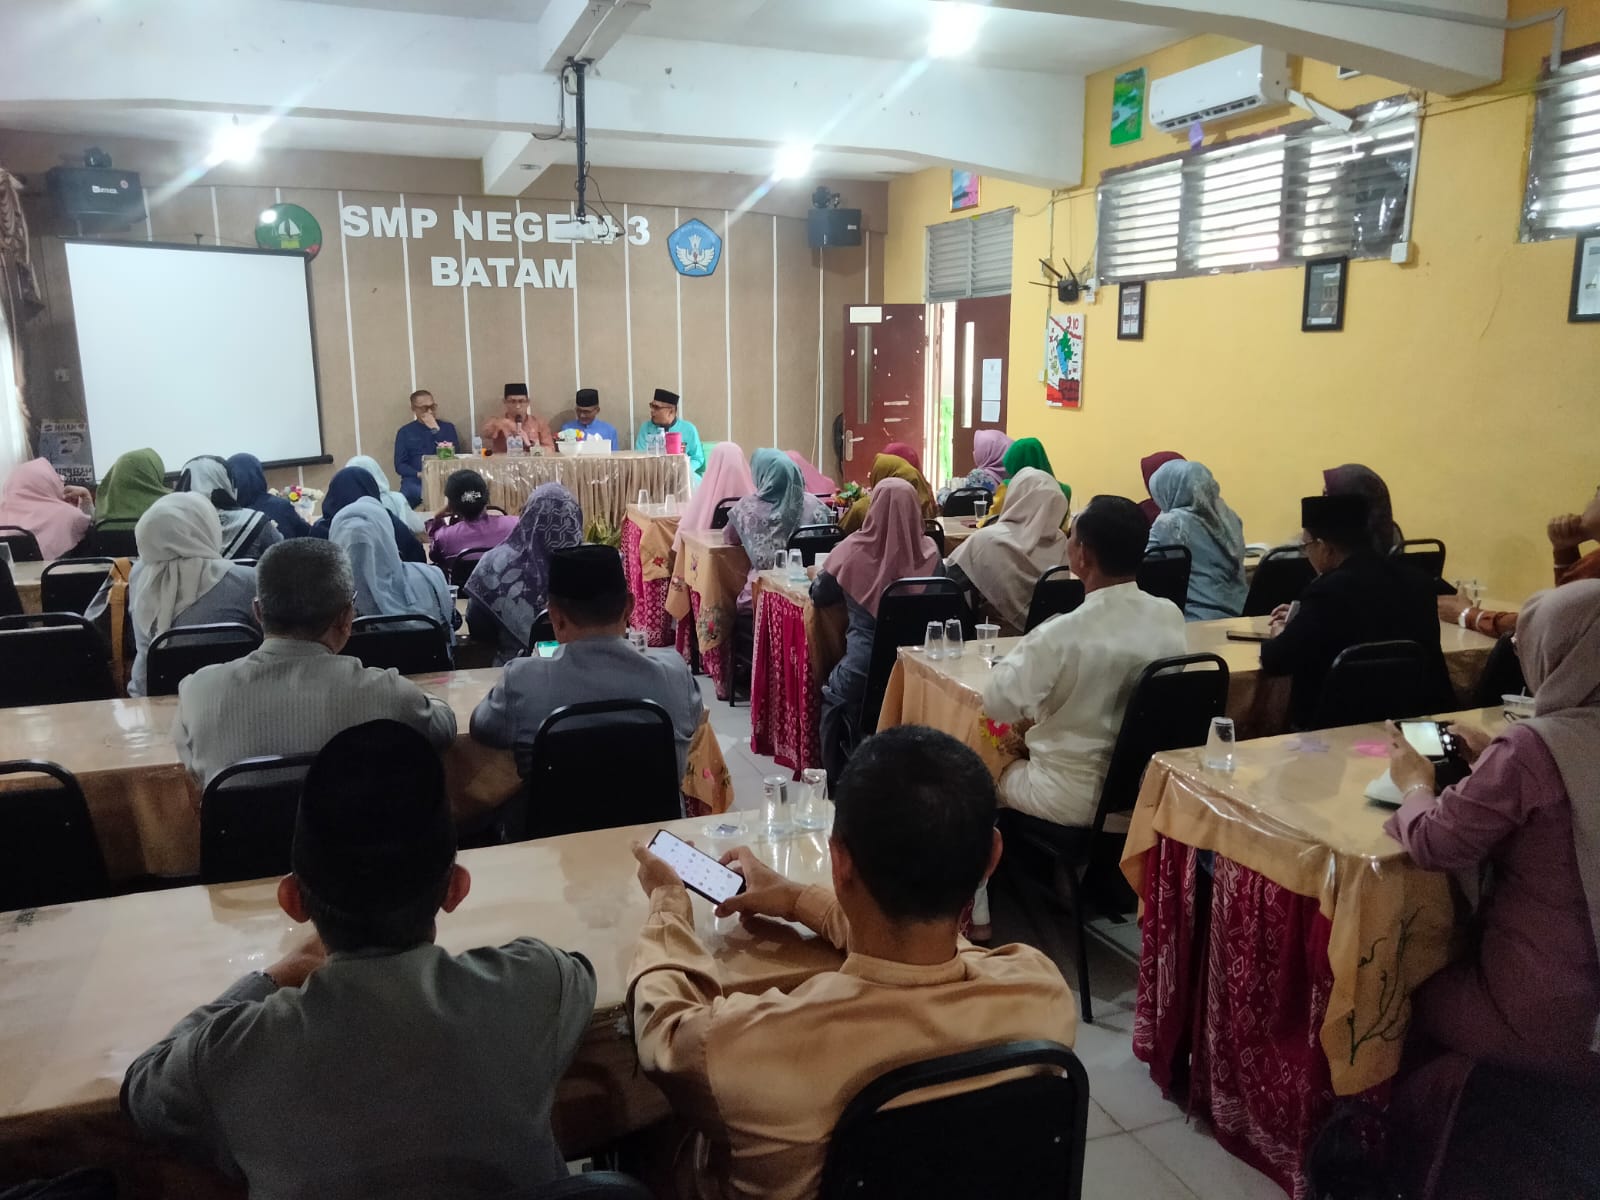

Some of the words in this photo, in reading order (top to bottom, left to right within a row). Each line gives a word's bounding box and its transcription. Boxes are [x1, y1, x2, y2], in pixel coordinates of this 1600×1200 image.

[341, 205, 438, 239] SMP
[628, 215, 650, 246] 3
[430, 256, 577, 289] BATAM
